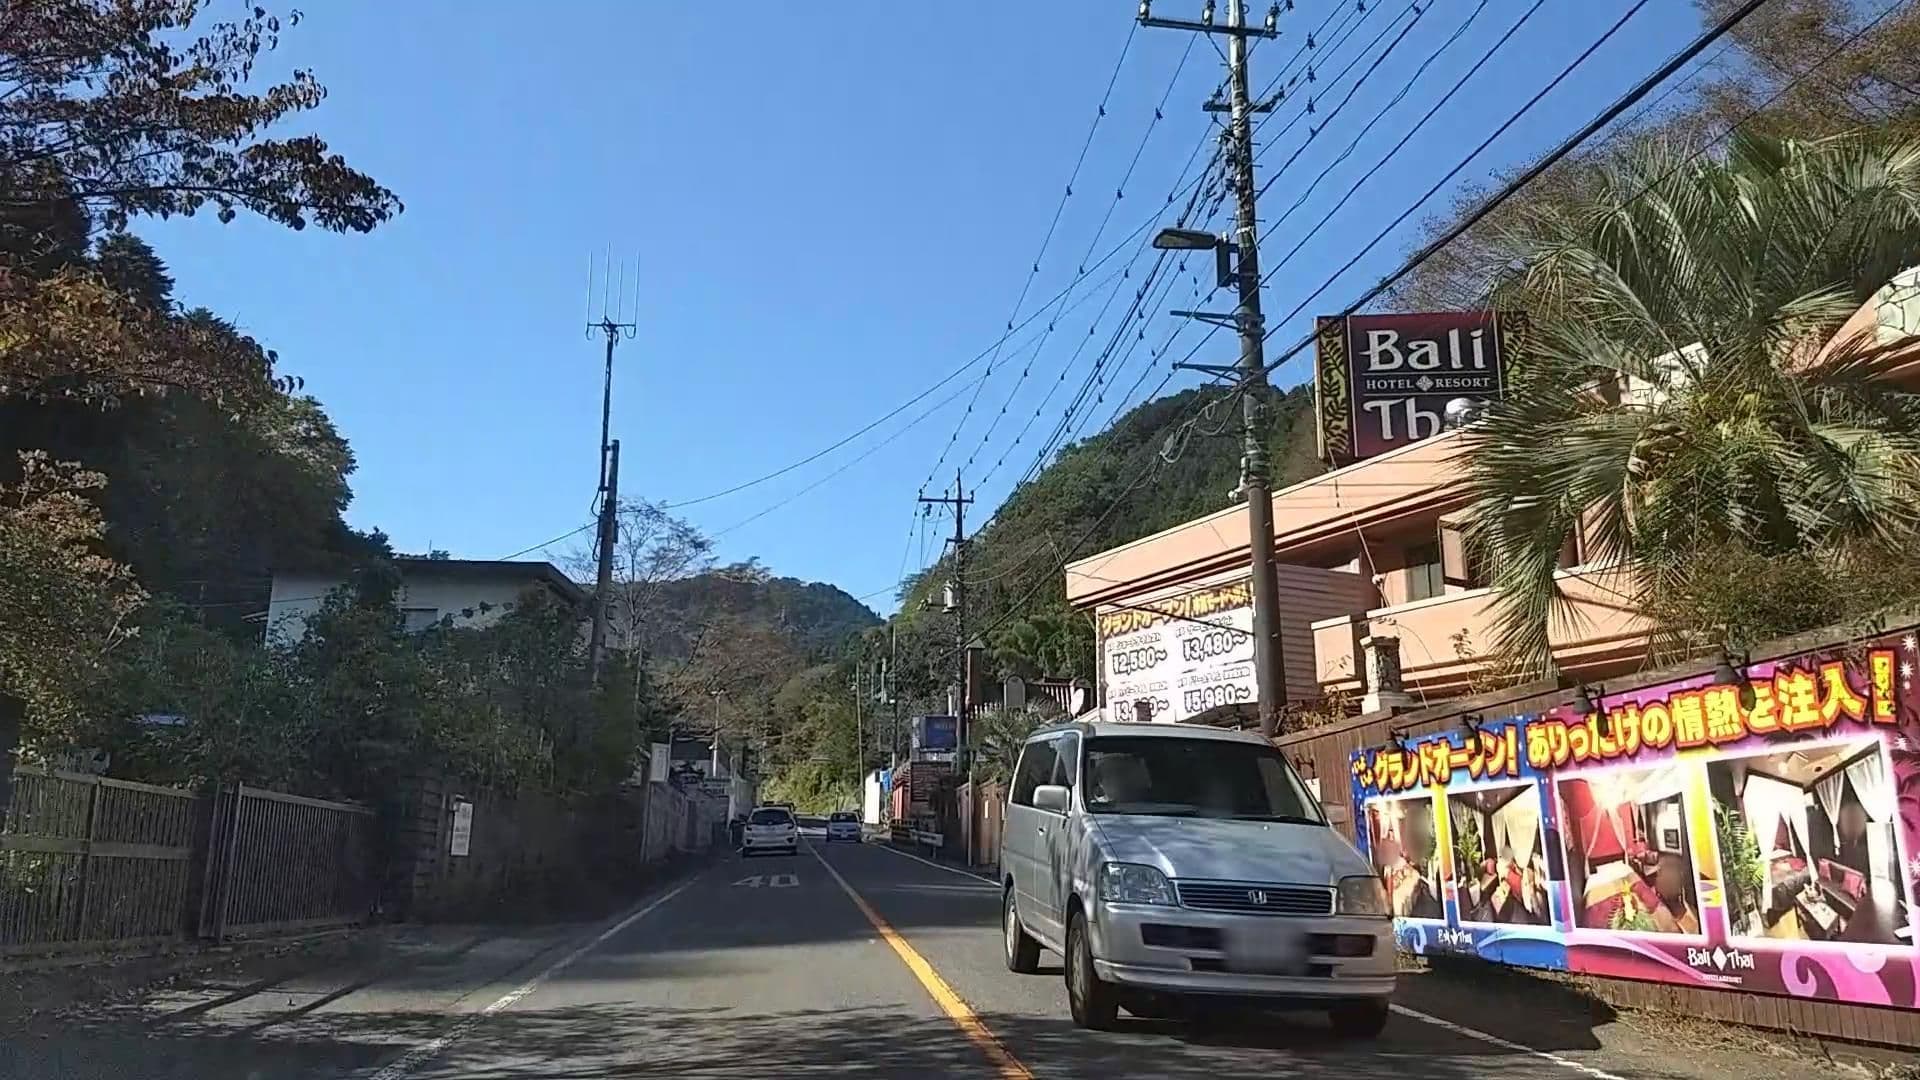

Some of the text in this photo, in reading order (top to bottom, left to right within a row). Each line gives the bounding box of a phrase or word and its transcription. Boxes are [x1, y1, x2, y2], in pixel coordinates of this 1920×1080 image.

[1360, 328, 1487, 371] Bali
[1366, 377, 1490, 390] HOTEL RESORT
[1687, 947, 1755, 970] Bali Thai
